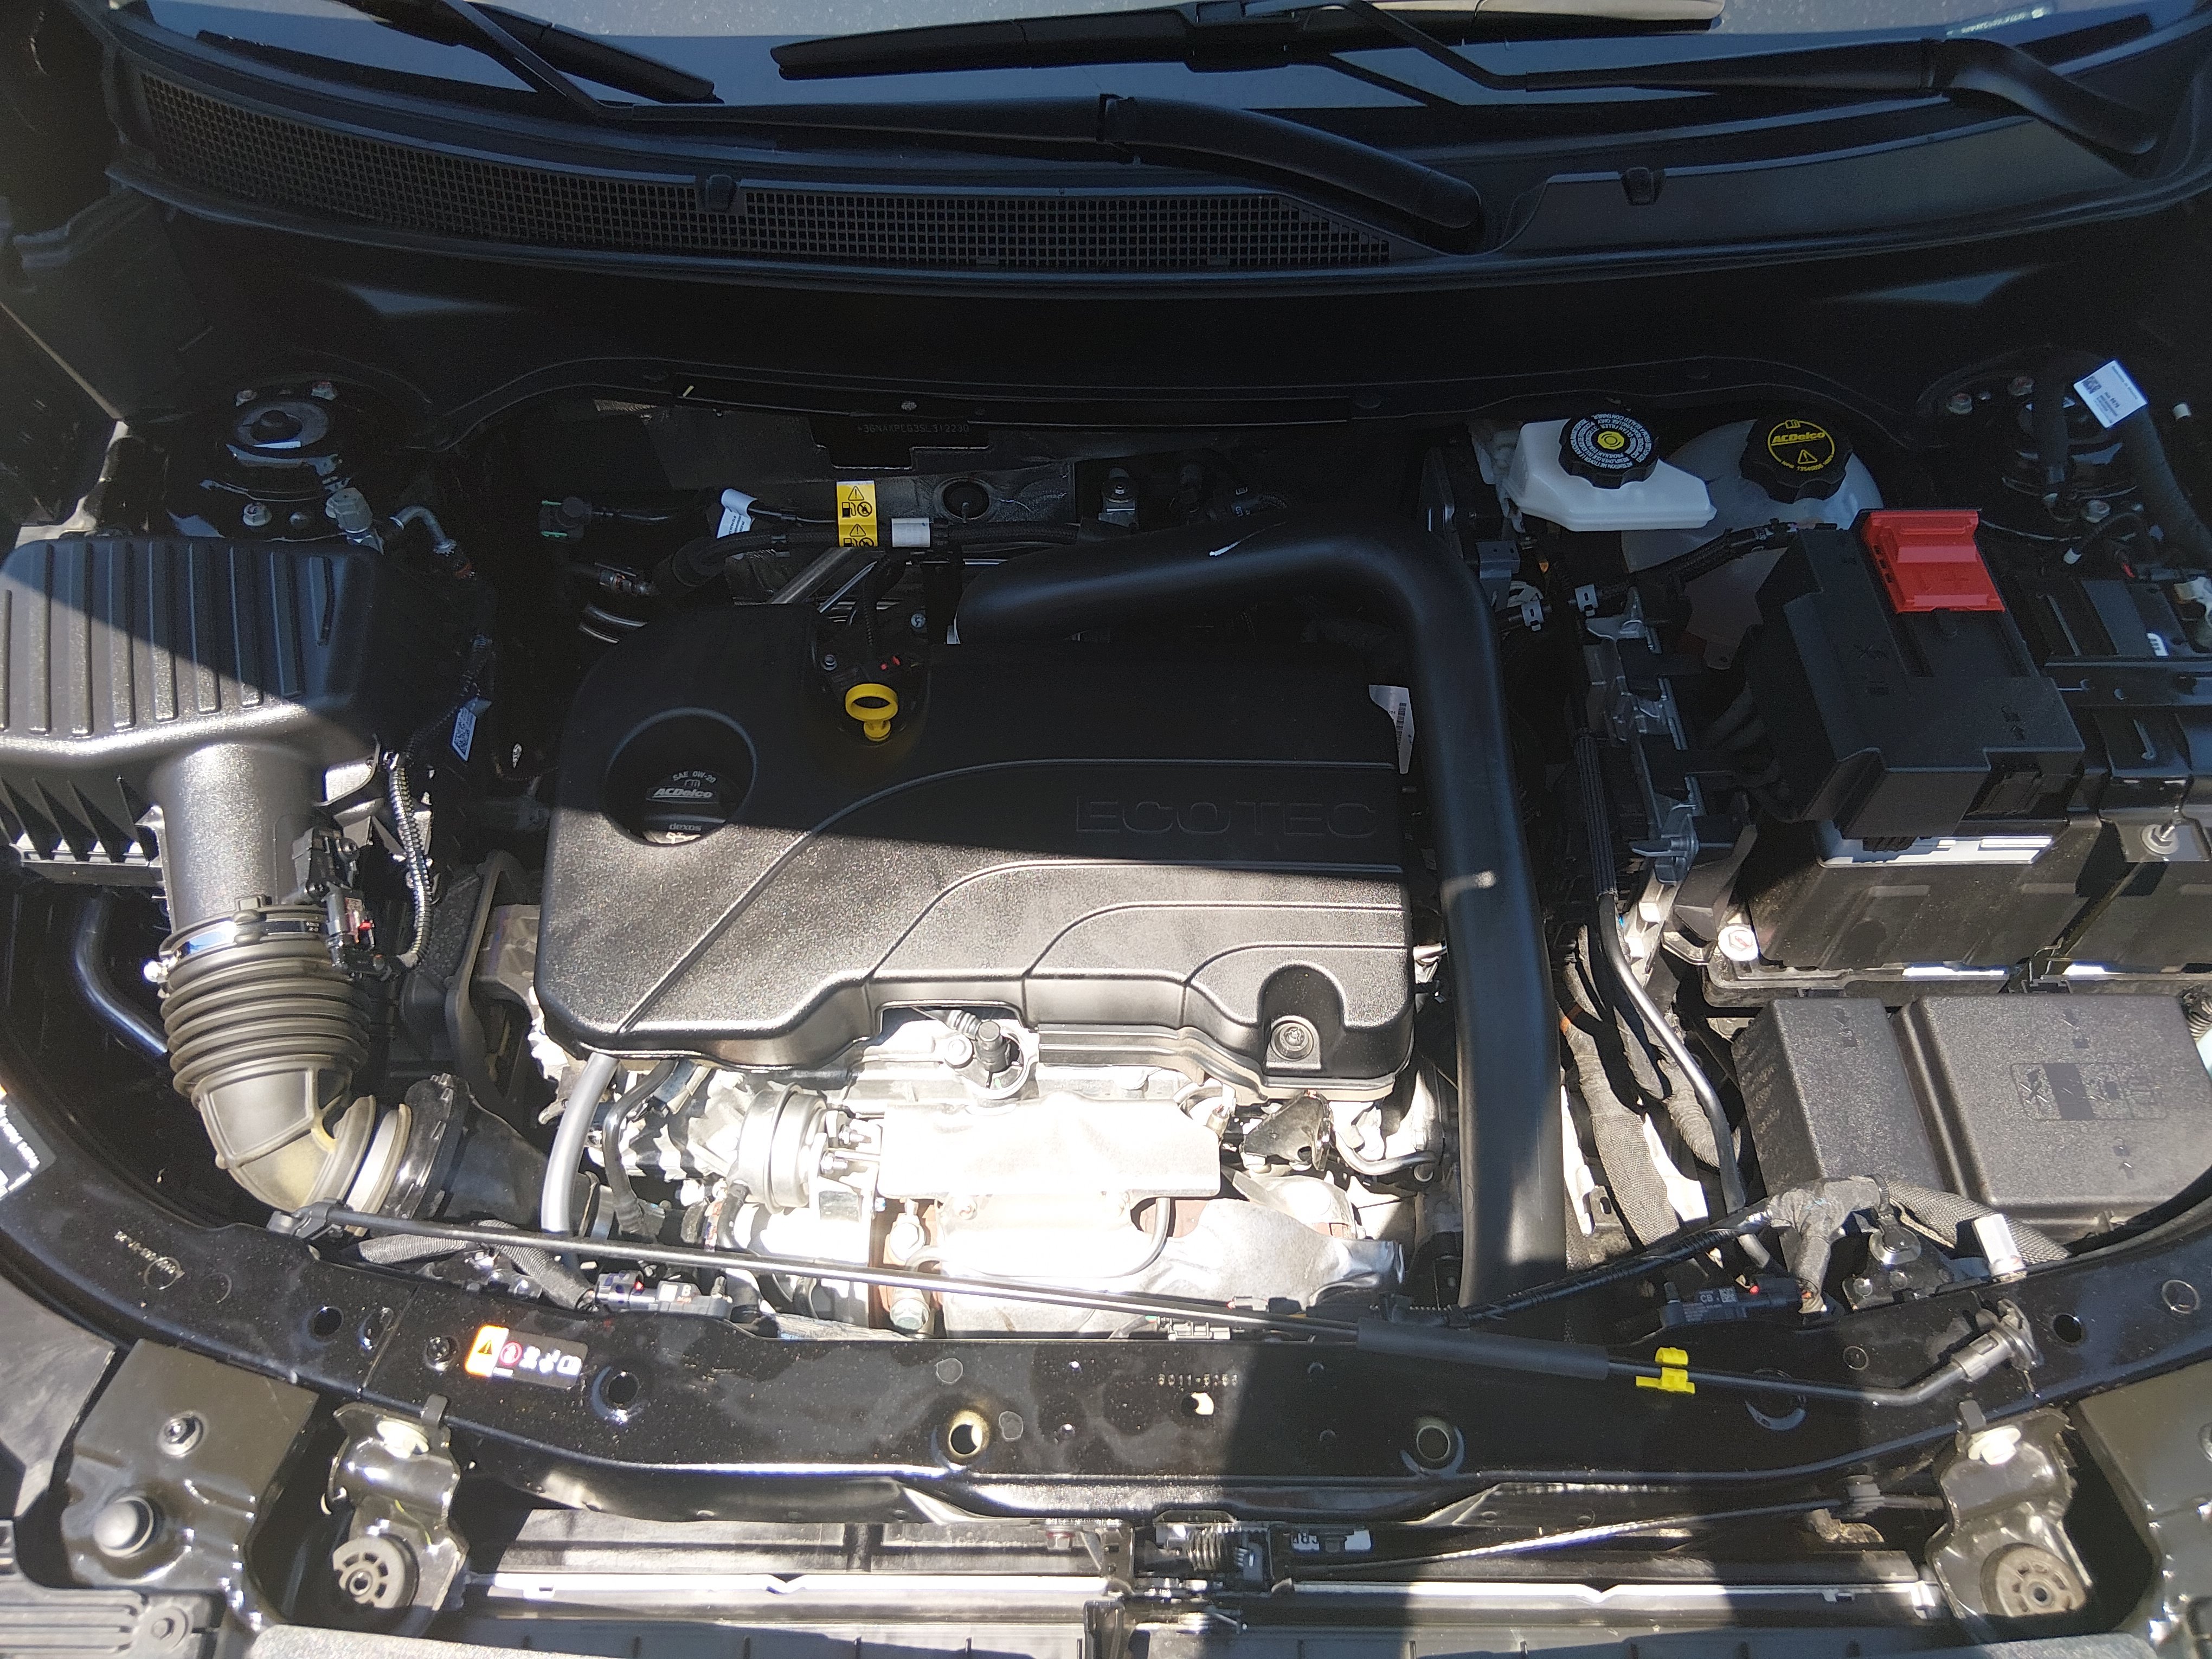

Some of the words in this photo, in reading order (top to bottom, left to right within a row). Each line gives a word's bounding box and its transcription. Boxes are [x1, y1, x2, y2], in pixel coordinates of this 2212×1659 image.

[1771, 432, 1826, 445] ACDelco
[672, 770, 690, 782] SAE
[692, 770, 717, 783] 0W-20
[652, 787, 714, 798] ACDelco
[1076, 795, 1378, 838] ECOTEC
[668, 822, 702, 832] dexos
